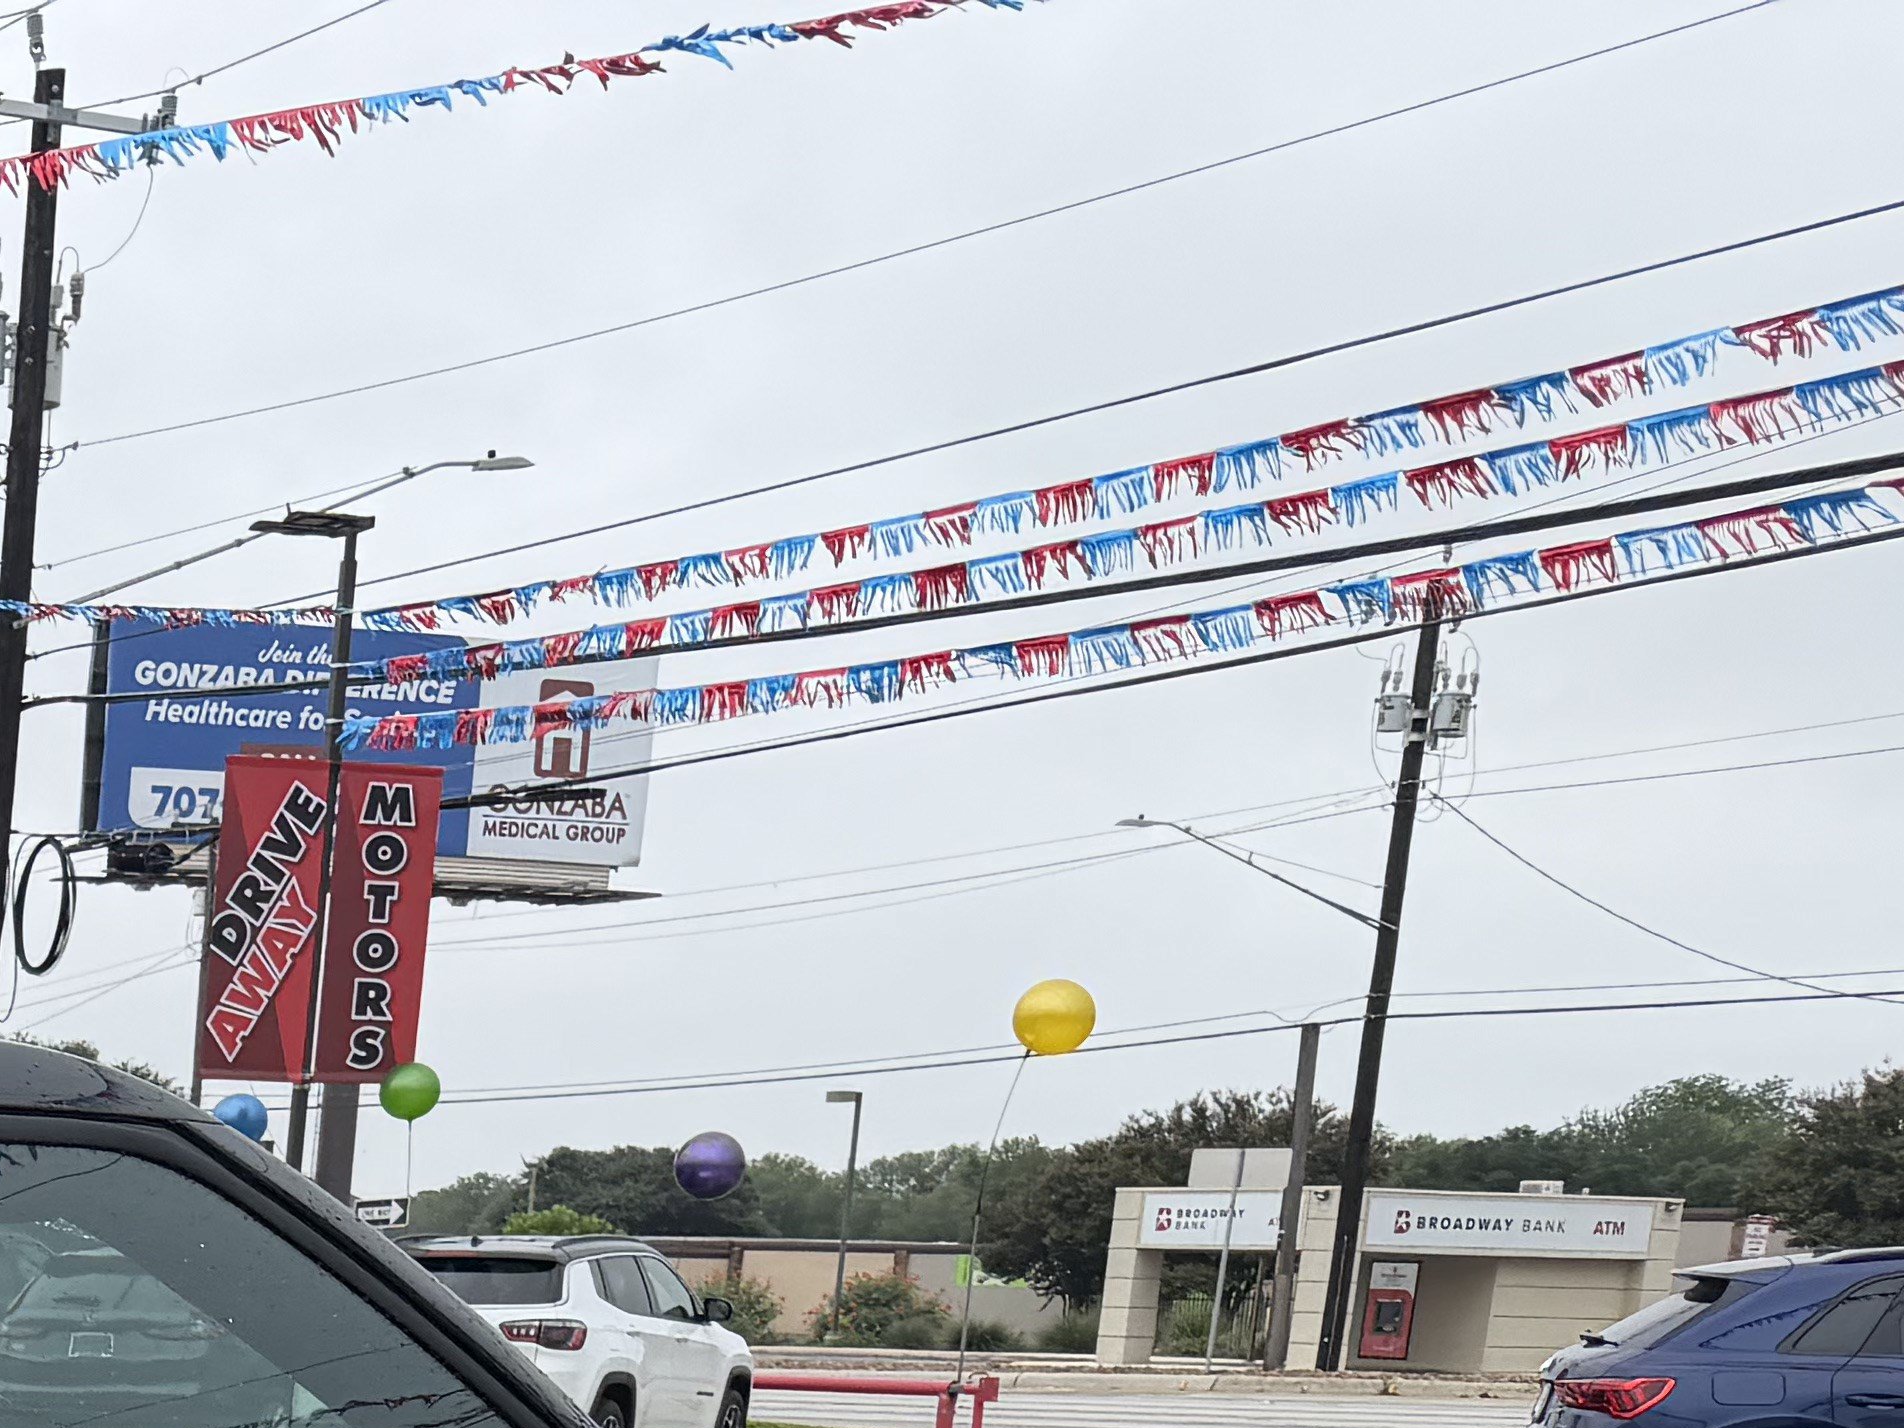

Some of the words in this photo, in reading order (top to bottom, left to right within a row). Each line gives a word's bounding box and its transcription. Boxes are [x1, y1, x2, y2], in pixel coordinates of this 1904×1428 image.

[258, 639, 302, 665] Join
[134, 660, 275, 690] GONZABA
[144, 699, 293, 730] Healthcare
[298, 705, 326, 732] fo
[482, 819, 560, 840] MEDICAL
[565, 824, 627, 844] GROUP
[209, 779, 328, 967] DRIVE
[345, 781, 417, 1071] MOTORS
[205, 875, 318, 1064] AWAY
[1416, 1216, 1514, 1232] BROADWAY
[1522, 1218, 1566, 1234] BANK
[1593, 1220, 1626, 1236] ATM
